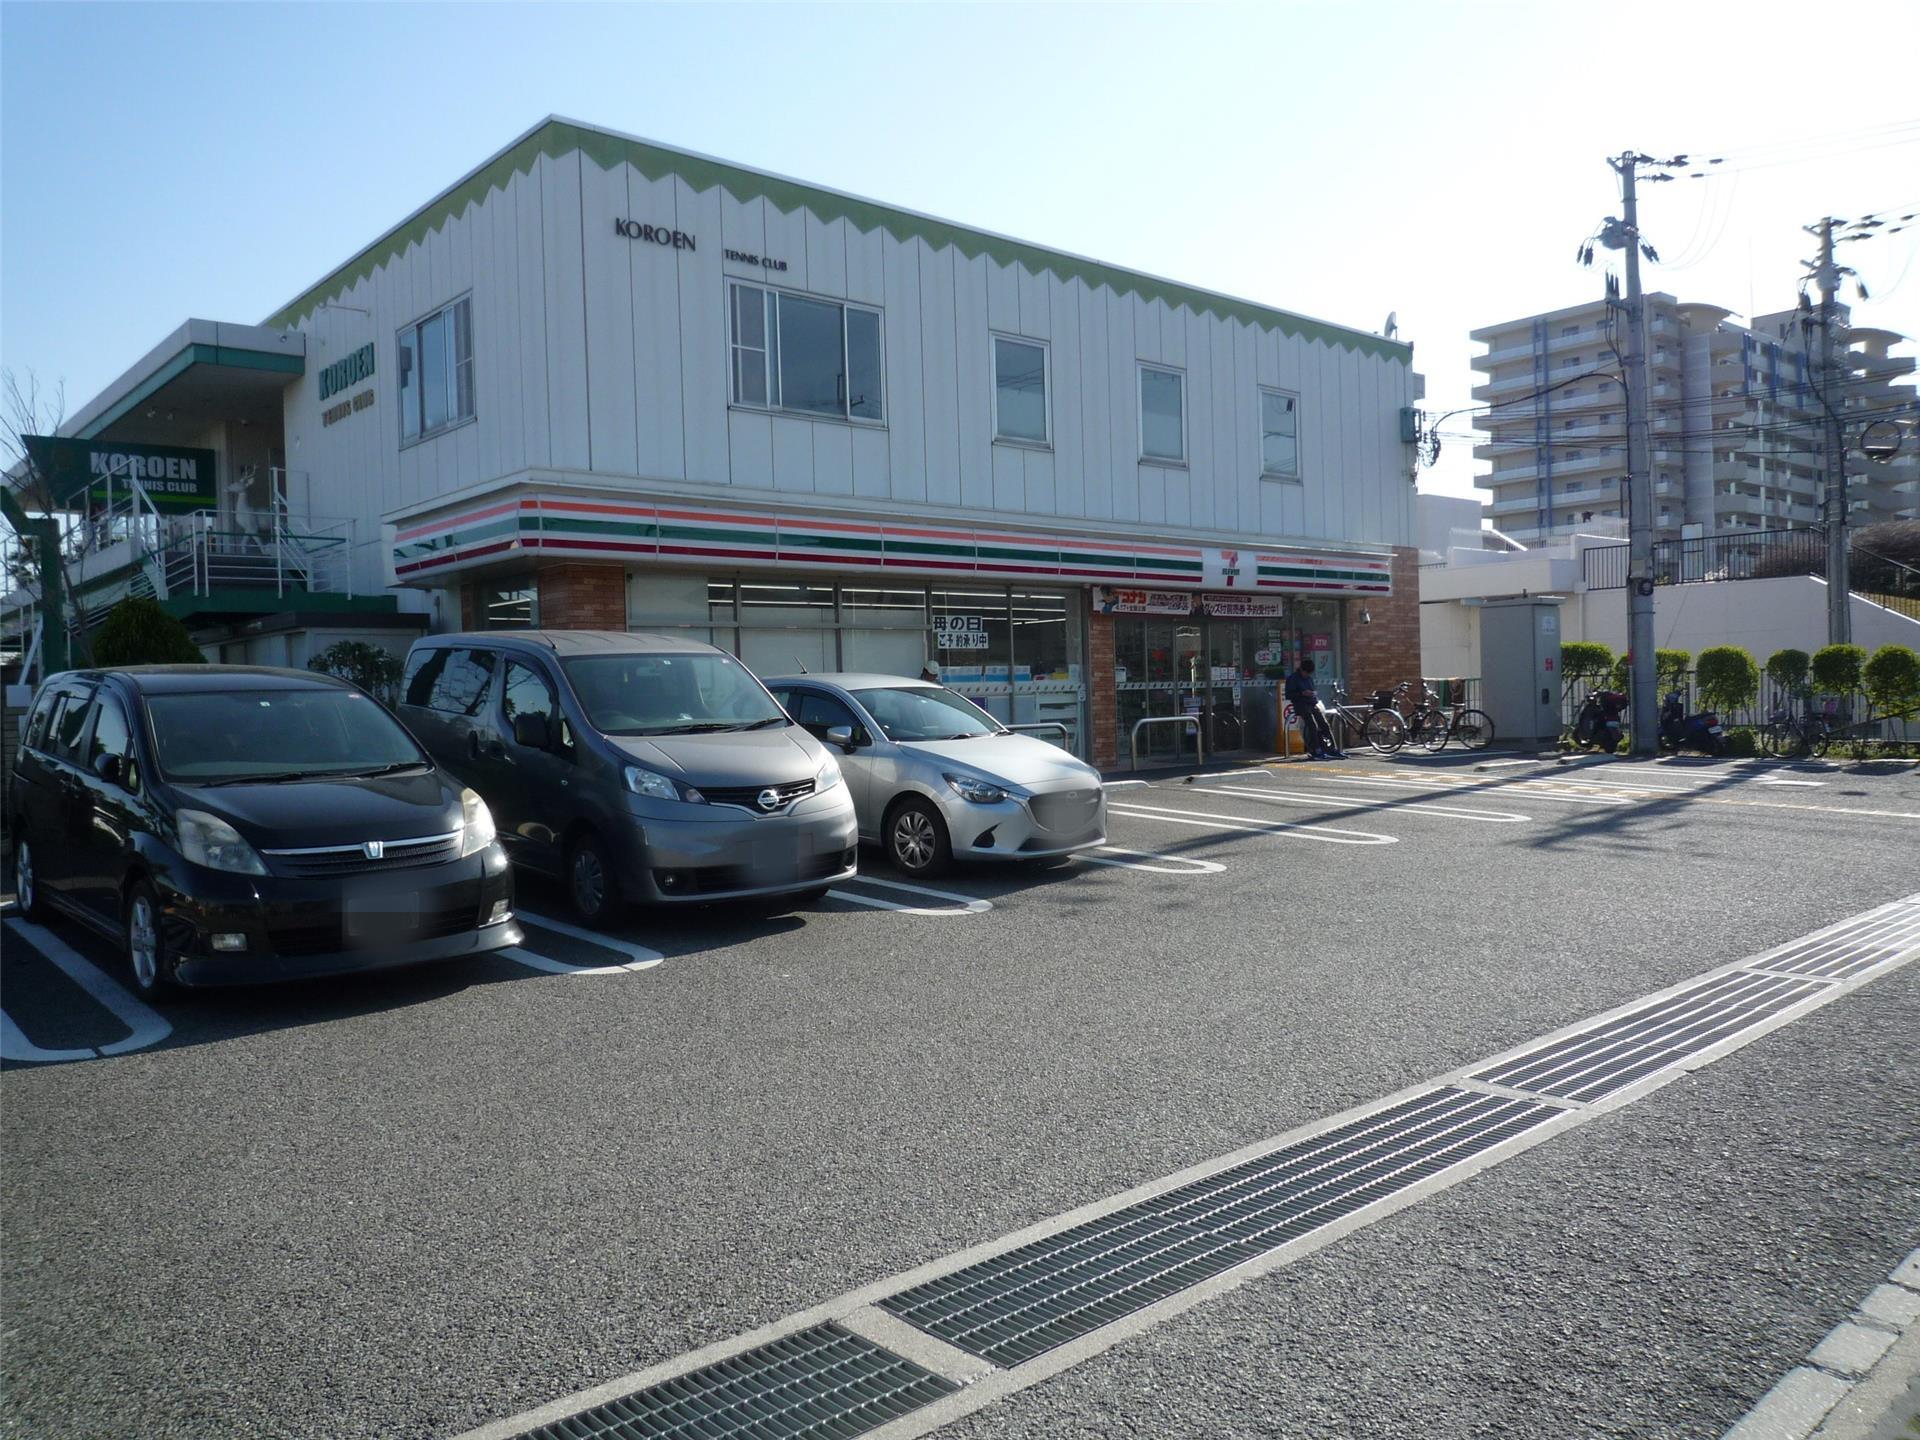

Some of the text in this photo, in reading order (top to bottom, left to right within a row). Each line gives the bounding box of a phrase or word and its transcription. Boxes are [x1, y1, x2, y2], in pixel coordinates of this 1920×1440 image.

[615, 217, 696, 251] KOROEN
[724, 249, 788, 271] TENNIS CLUB
[319, 342, 375, 401] KOROEN
[90, 452, 197, 480] KOROEN
[167, 482, 198, 493] CLUB
[933, 617, 981, 631] 母の日
[939, 634, 987, 647] ご予約承り中
